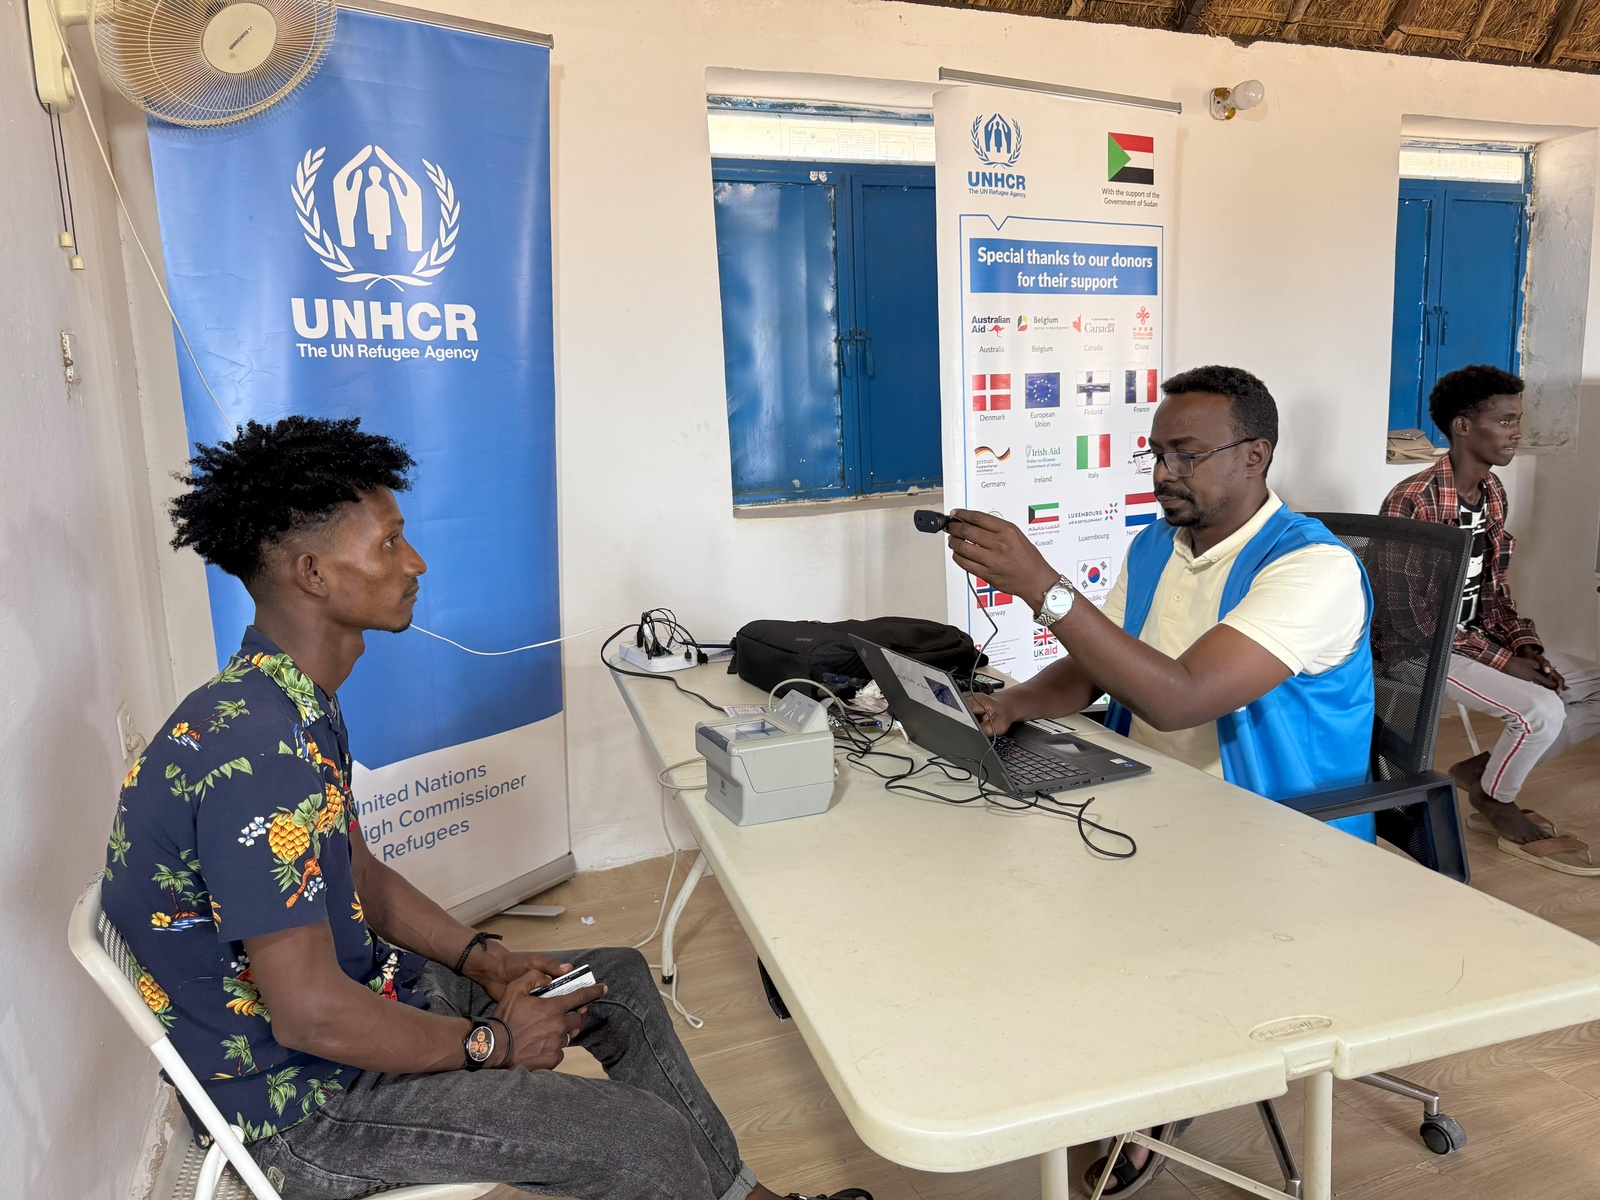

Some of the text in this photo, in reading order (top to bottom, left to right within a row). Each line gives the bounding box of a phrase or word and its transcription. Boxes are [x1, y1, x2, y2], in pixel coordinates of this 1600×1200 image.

[967, 171, 1026, 191] UNHCR
[980, 188, 988, 196] UN
[989, 188, 1009, 198] Refugee
[1010, 190, 1026, 199] Agency
[1102, 188, 1160, 199] With the support of the
[1104, 197, 1158, 208] Government of Sudan
[977, 246, 1153, 268] Special thanks to our donors
[1017, 272, 1118, 291] for their support
[291, 297, 478, 341] UNHCR
[971, 315, 1011, 324] Australian
[1034, 316, 1059, 325] Belgium
[971, 325, 986, 333] Aid
[1084, 323, 1115, 333] Canada
[296, 343, 479, 362] The UN Refugee Agency
[1032, 345, 1053, 353] Belgium
[1084, 344, 1103, 352] Canada
[1030, 411, 1055, 420] European
[1084, 408, 1103, 416] Finland
[980, 414, 1006, 422] Denmark
[1032, 446, 1060, 456] Irish Aid
[981, 480, 1006, 488] Germany
[1068, 510, 1102, 518] LUXEMBOURG
[1079, 532, 1109, 542] Luxembourg
[415, 764, 487, 797] Nations
[364, 775, 527, 845] igh Commissioner
[382, 820, 470, 862] Refugees
